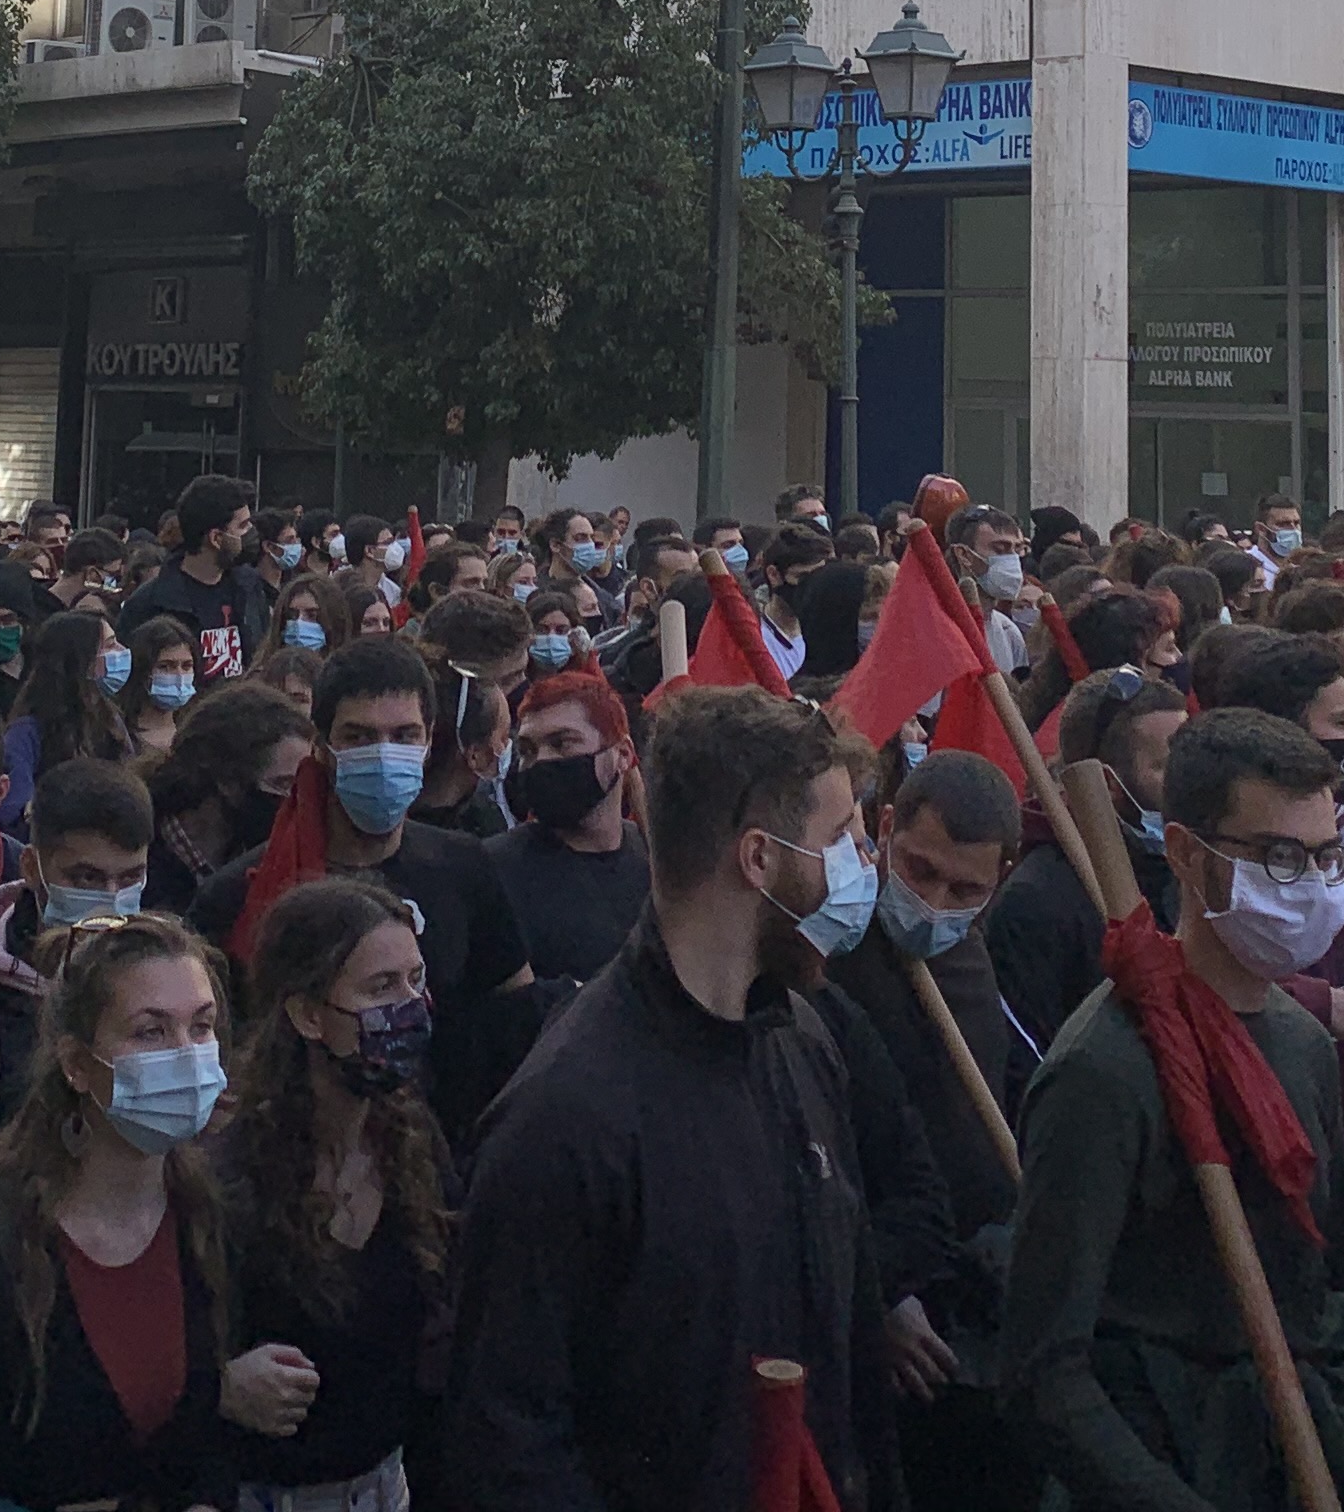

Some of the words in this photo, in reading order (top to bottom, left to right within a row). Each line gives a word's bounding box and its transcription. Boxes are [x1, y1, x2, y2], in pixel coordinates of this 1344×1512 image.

[979, 80, 1032, 120] BANK
[1153, 89, 1213, 130] ΠΟΛΥΙΑΤΡΕΙΑ
[1216, 97, 1263, 136] ΣΥΛΛΟΓΟΥ
[1266, 104, 1321, 142] ΠΡΟΣΩΠΙΚΟΥ
[810, 142, 931, 169] ΠΑΟΧΟΣ:
[931, 138, 971, 163] ALFA
[999, 134, 1032, 160] LIFE
[1145, 321, 1235, 339] ΠΟΛΥΙΑΤΡΕΙΑ
[85, 342, 241, 376] ΚΟΥΤΡΟΥΛΗΣ
[1128, 345, 1179, 362] ΛΛΟΓΟΥ
[1183, 346, 1273, 364] ΠΡΟΣΩΠΙΚΟΥ
[1148, 369, 1192, 387] ALPHA
[1195, 370, 1234, 388] BANK
